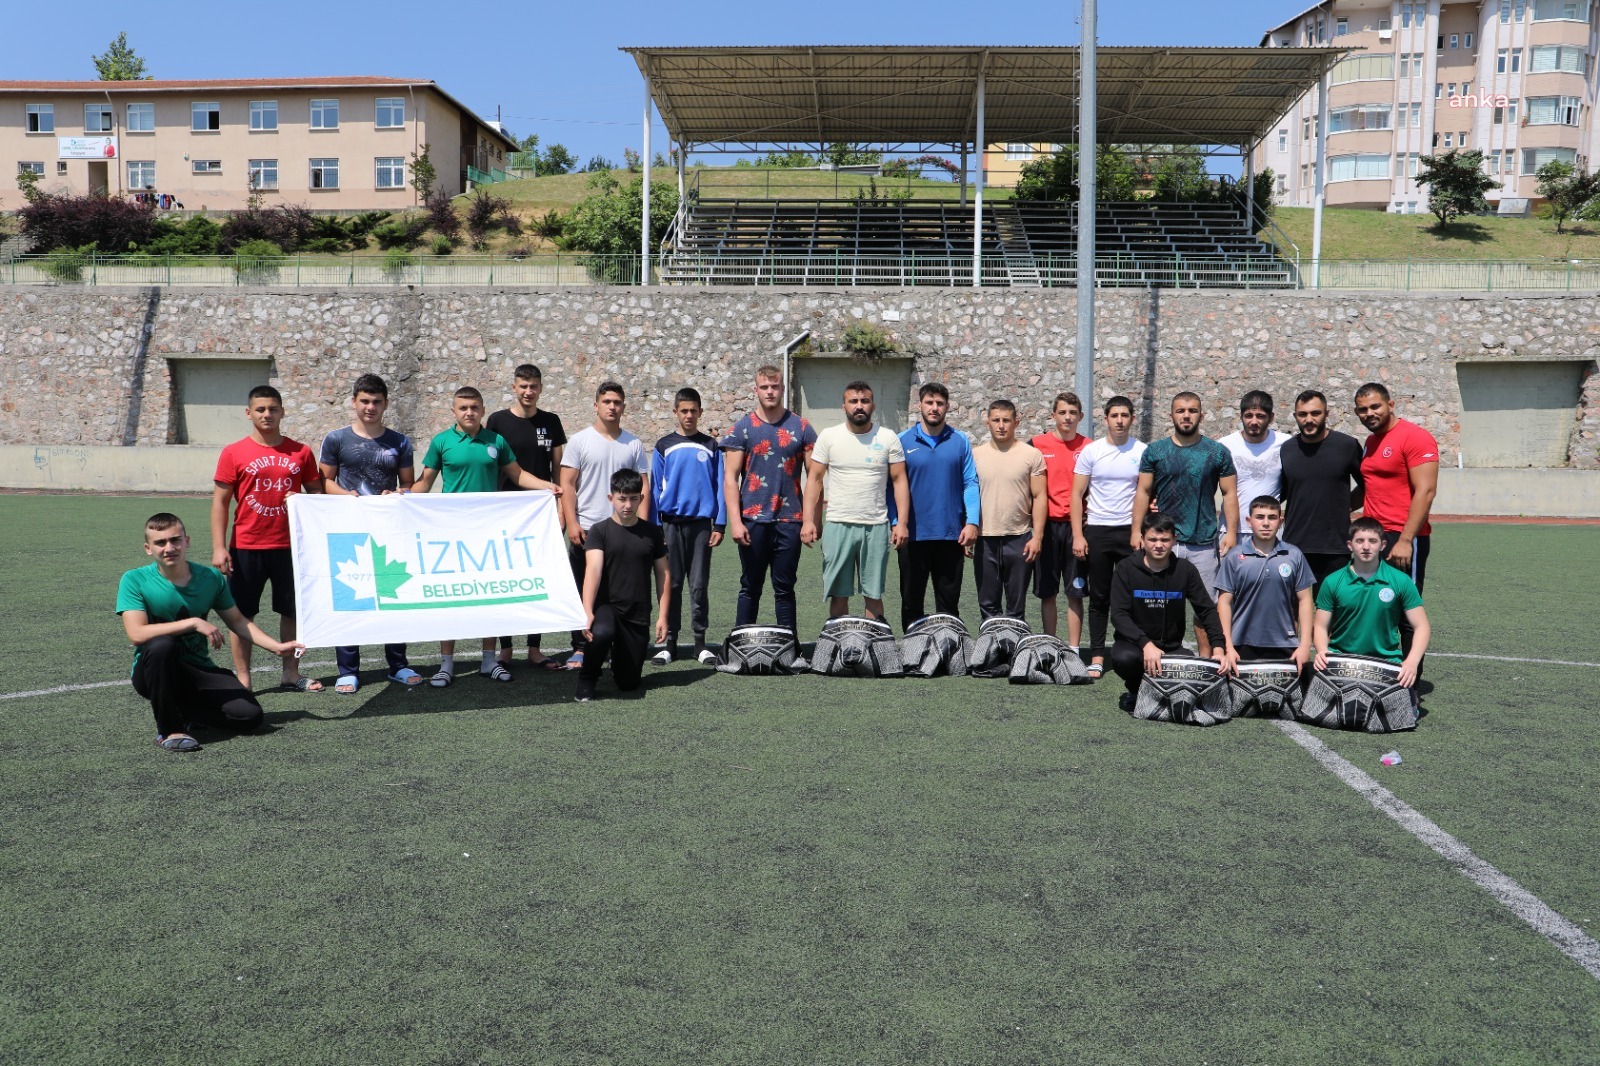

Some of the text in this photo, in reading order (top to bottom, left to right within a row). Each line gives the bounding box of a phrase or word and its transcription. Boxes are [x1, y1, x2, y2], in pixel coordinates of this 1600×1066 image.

[245, 456, 301, 476] SPORT 1949
[253, 477, 293, 492] 1949
[245, 494, 288, 517] CONNECTI
[415, 530, 535, 575] İZMİT
[347, 573, 372, 582] 1977
[422, 577, 546, 598] BELEDİYESPOR
